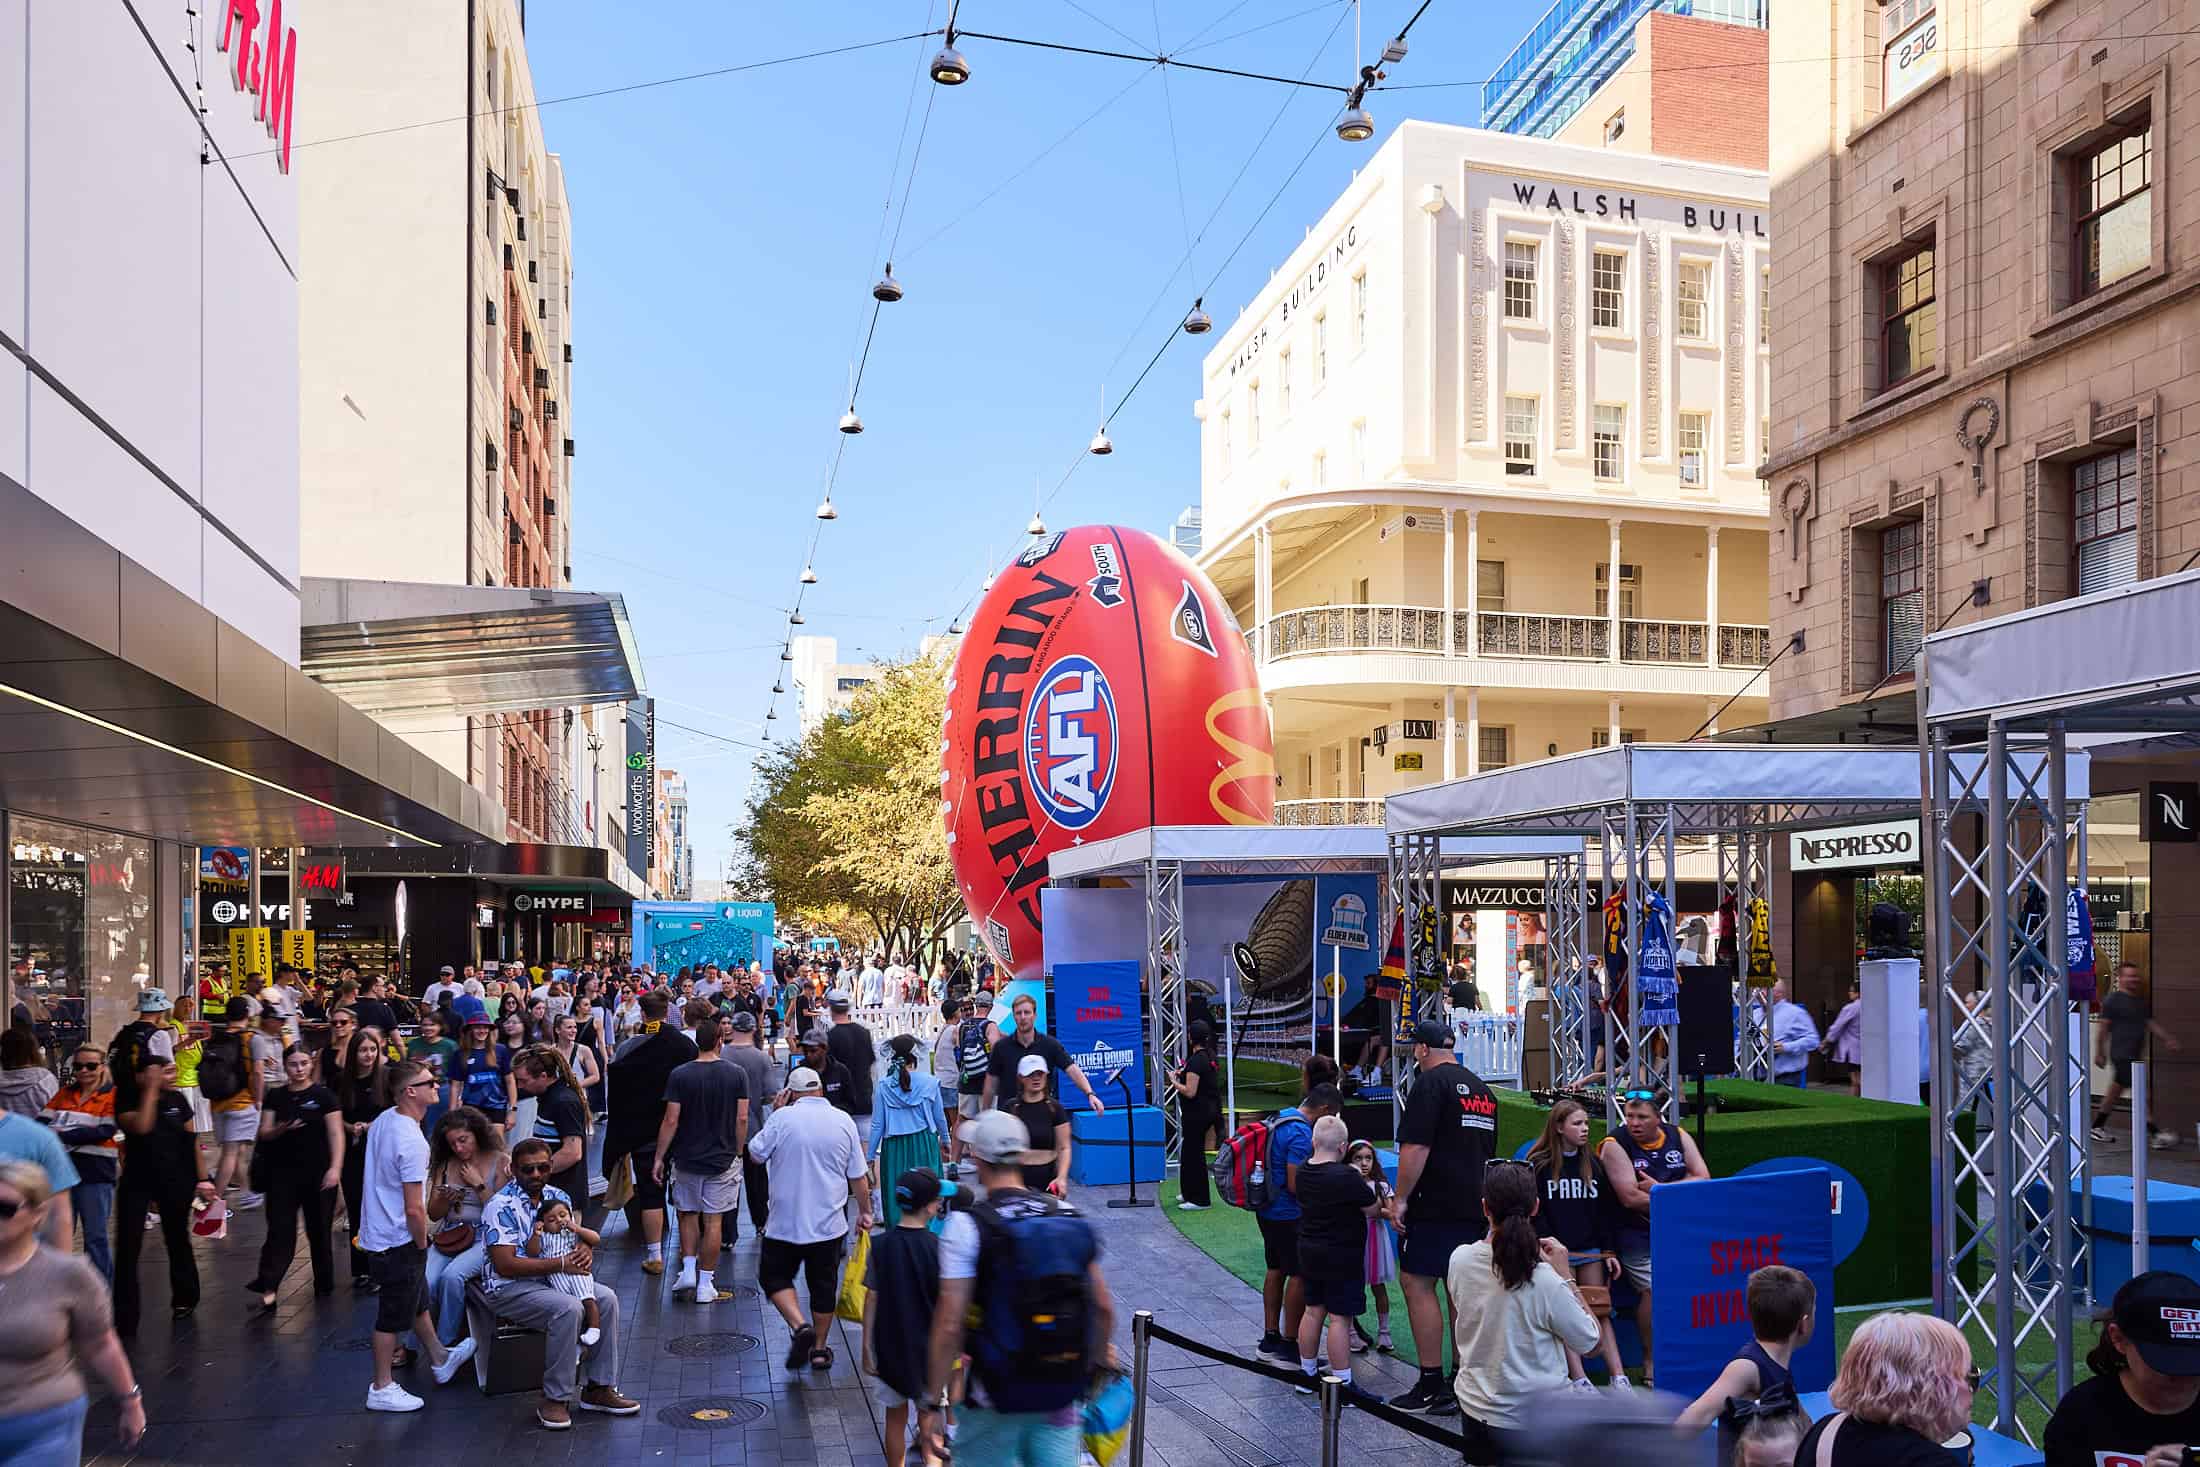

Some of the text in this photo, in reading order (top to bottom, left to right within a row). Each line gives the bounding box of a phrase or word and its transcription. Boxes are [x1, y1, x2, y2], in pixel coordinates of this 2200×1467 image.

[1513, 183, 1766, 237] WALSH BUIL
[1230, 225, 1356, 377] WALSH BUILDING
[1048, 670, 1097, 811] AFL
[631, 775, 644, 836] Woolworths
[1796, 832, 1911, 864] NESPRESSO
[301, 864, 341, 889] H&M
[533, 898, 584, 909] HYPE
[737, 908, 763, 917] LIQUID
[236, 934, 247, 976] ZONE
[258, 933, 268, 974] ZONE
[293, 934, 305, 968] ZONE
[1104, 1049, 1134, 1064] ROUND
[1547, 1178, 1598, 1199] PARIS
[1711, 1234, 1785, 1275] SPACE
[2162, 1309, 2199, 1320] GET
